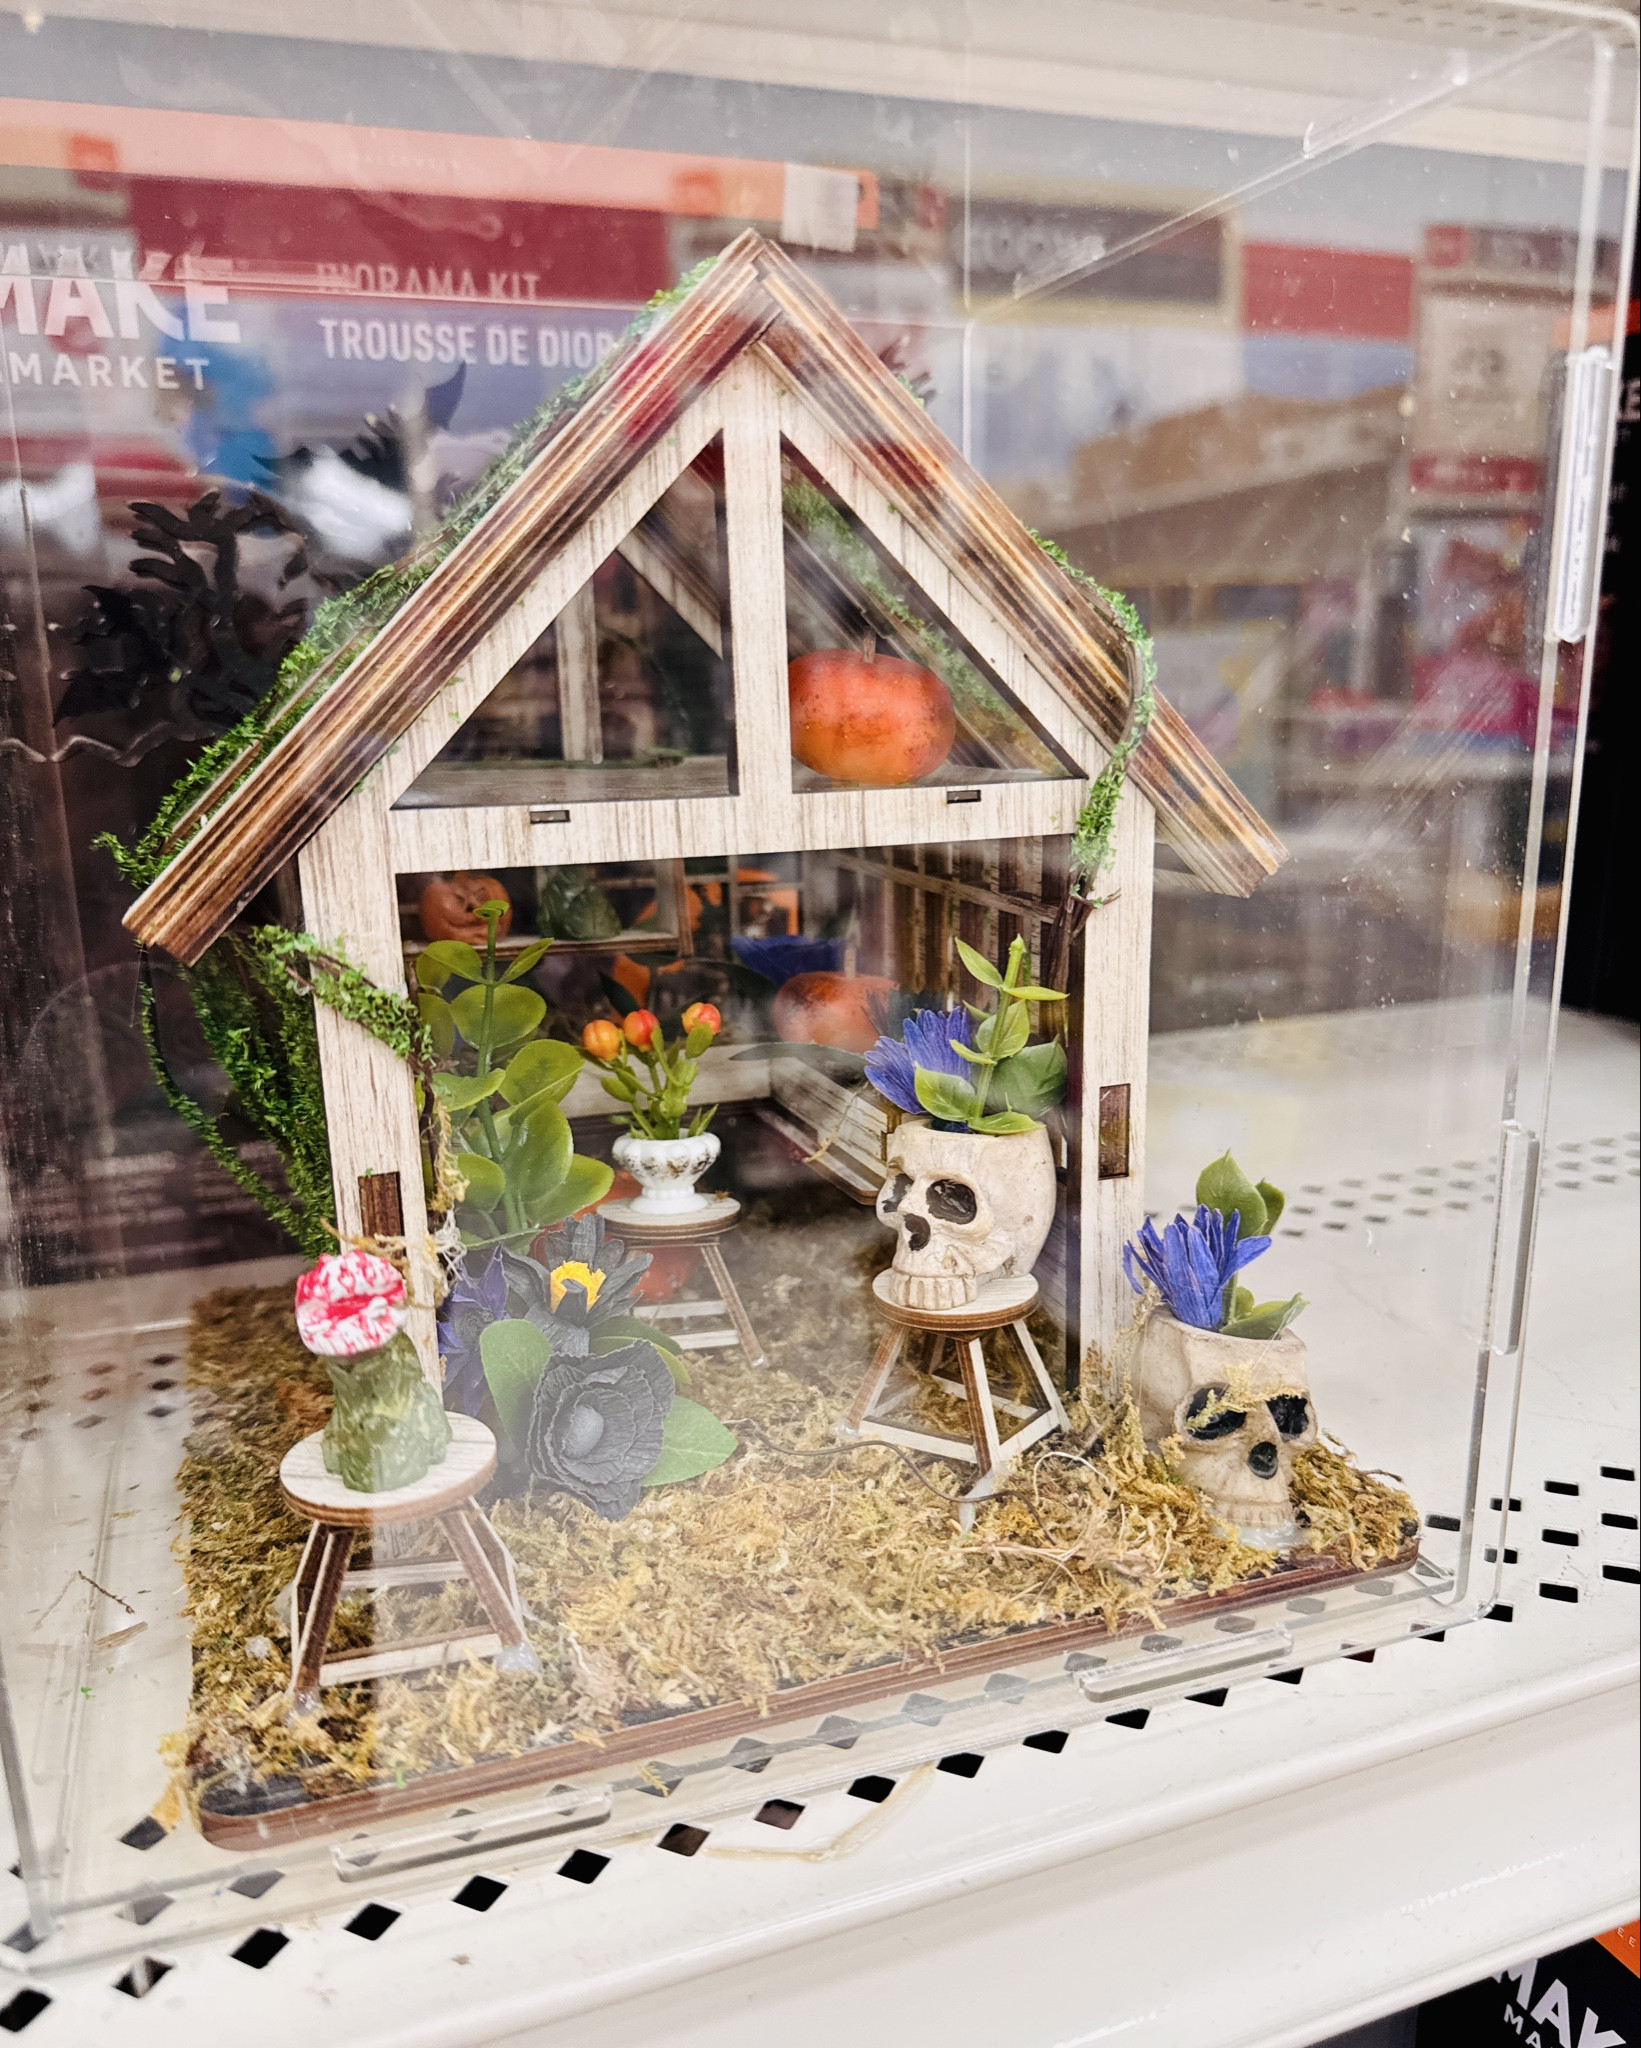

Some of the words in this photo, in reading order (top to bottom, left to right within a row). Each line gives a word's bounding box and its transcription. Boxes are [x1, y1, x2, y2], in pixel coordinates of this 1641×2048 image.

[488, 271, 540, 301] KIT
[318, 318, 477, 364] TROUSSE
[486, 324, 530, 367] DE
[8, 352, 210, 391] MARKET
